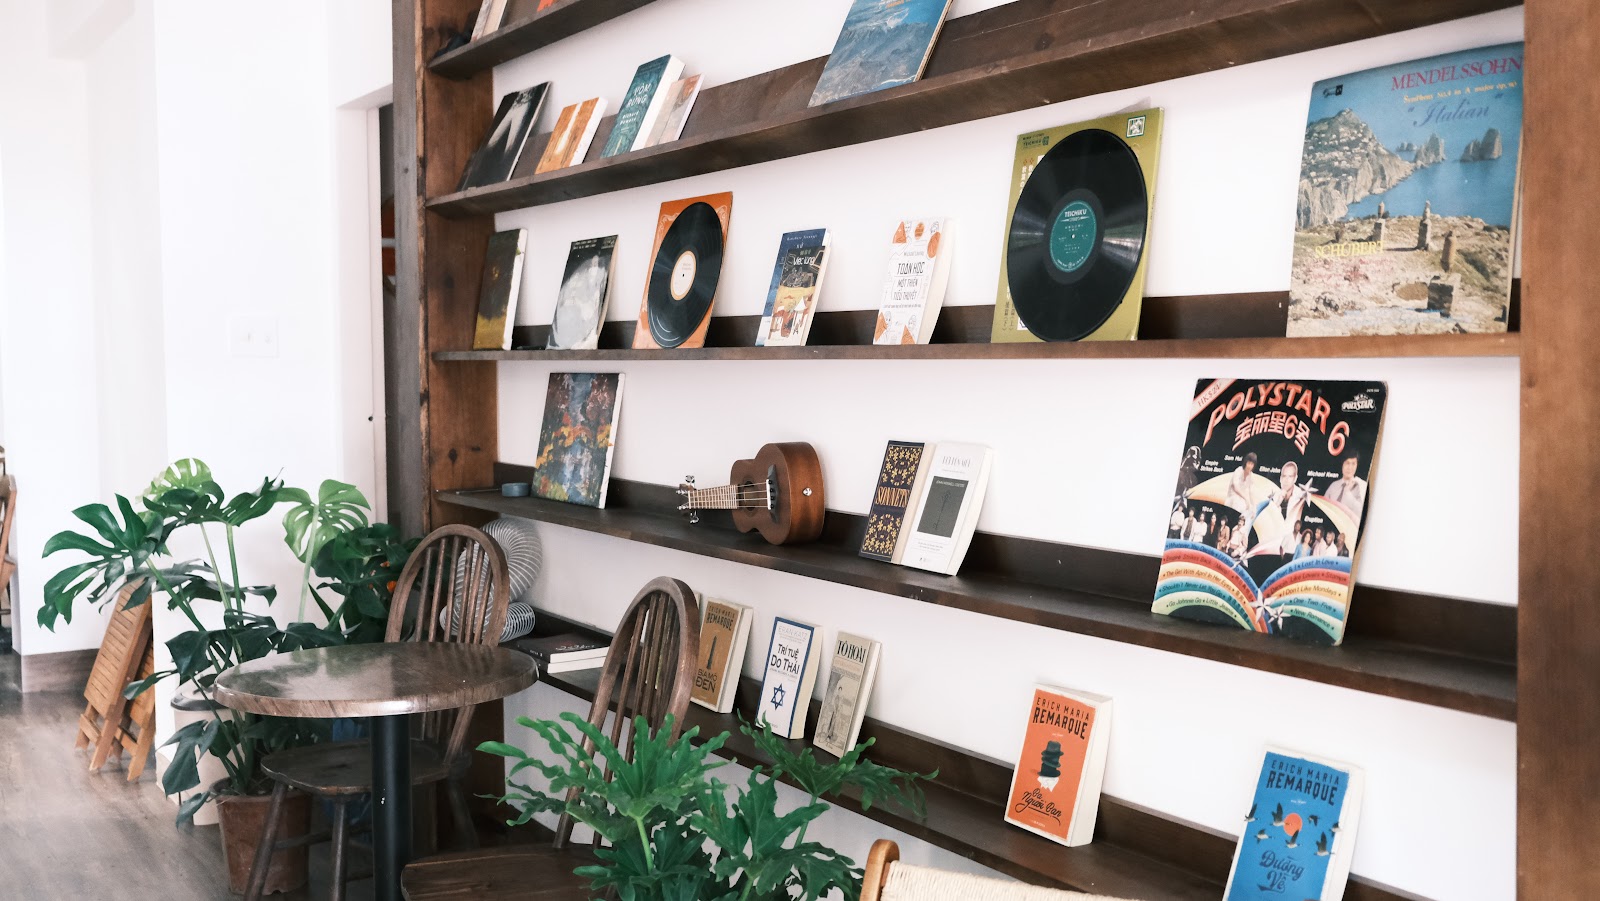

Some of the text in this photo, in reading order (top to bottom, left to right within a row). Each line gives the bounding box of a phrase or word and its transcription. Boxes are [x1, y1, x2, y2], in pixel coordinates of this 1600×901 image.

[1391, 56, 1523, 91] MENDELSSOHN
[1315, 241, 1384, 258] SCHUBERT
[1202, 381, 1350, 456] POLYSTAR 6
[1306, 470, 1326, 478] Michael
[875, 486, 910, 508] SONNETS
[1301, 559, 1314, 567] Lost
[1321, 557, 1335, 565] Love
[1285, 587, 1300, 595] Don't
[1313, 585, 1337, 596] Mondays
[1205, 597, 1219, 606] Little
[706, 612, 734, 631] REMARQUE
[1294, 608, 1330, 628] New Romance
[777, 643, 799, 660] TRÍ TUỆ
[836, 640, 867, 664] TÔ HOÀI
[783, 658, 801, 675] THÁI
[695, 676, 717, 693] ĐEN
[1036, 697, 1090, 721] ERICH MARIA
[1032, 707, 1089, 740] REMARQUE
[1271, 759, 1340, 785] ERICH MARIA
[1032, 787, 1043, 800] Ba
[1266, 770, 1338, 806] REMARQUE
[1259, 850, 1305, 881] Đường
[1262, 870, 1286, 893] Về
